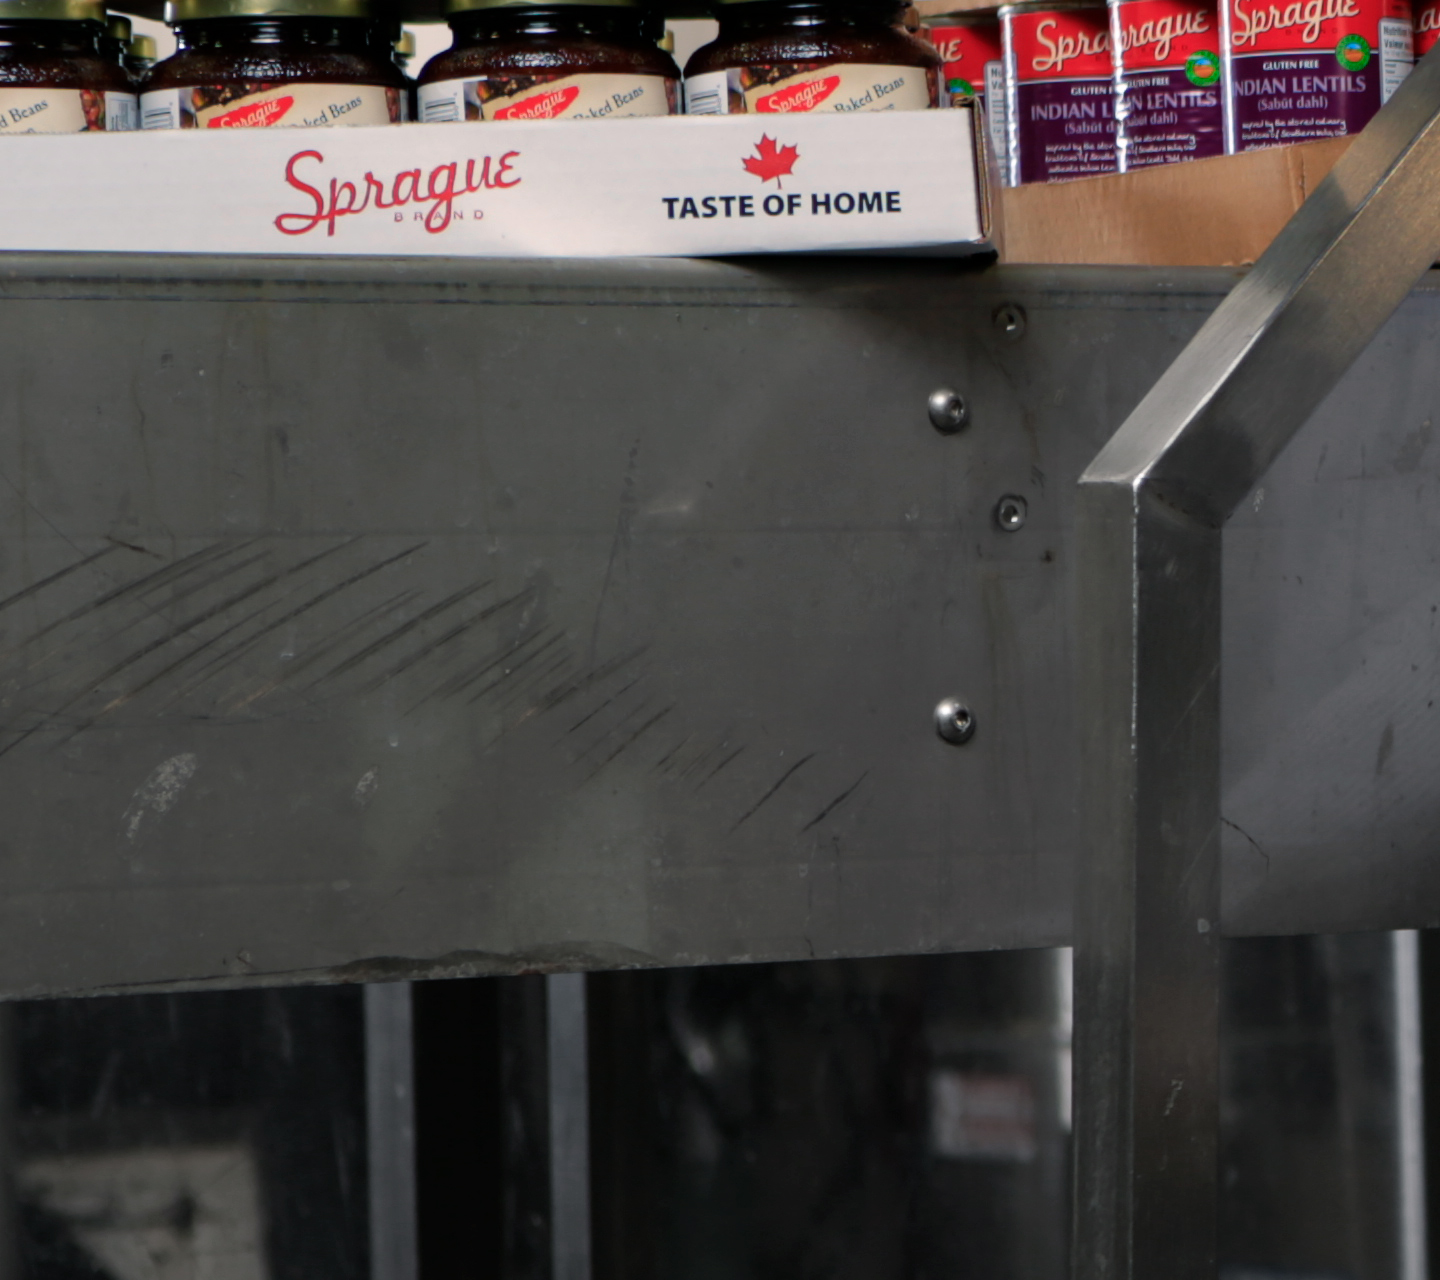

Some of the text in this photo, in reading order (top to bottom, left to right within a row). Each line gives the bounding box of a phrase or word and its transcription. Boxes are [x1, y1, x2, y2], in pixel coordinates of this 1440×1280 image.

[1263, 59, 1319, 71] GLUTEN FREE
[872, 77, 905, 99] Beans
[1070, 86, 1106, 96] GLUTEN
[1151, 77, 1169, 86] FREE
[1234, 75, 1366, 96] NDIAN LENTILS
[612, 86, 644, 108] Beans
[768, 79, 828, 112] Sprague
[1296, 95, 1328, 109] dahl)
[8, 101, 49, 123] Beans
[328, 96, 362, 119] Beans
[1031, 102, 1096, 121] INDIAN
[273, 148, 522, 237] Sprague
[662, 190, 902, 219] TASTE OF HOME
[394, 209, 484, 222] BRAND
